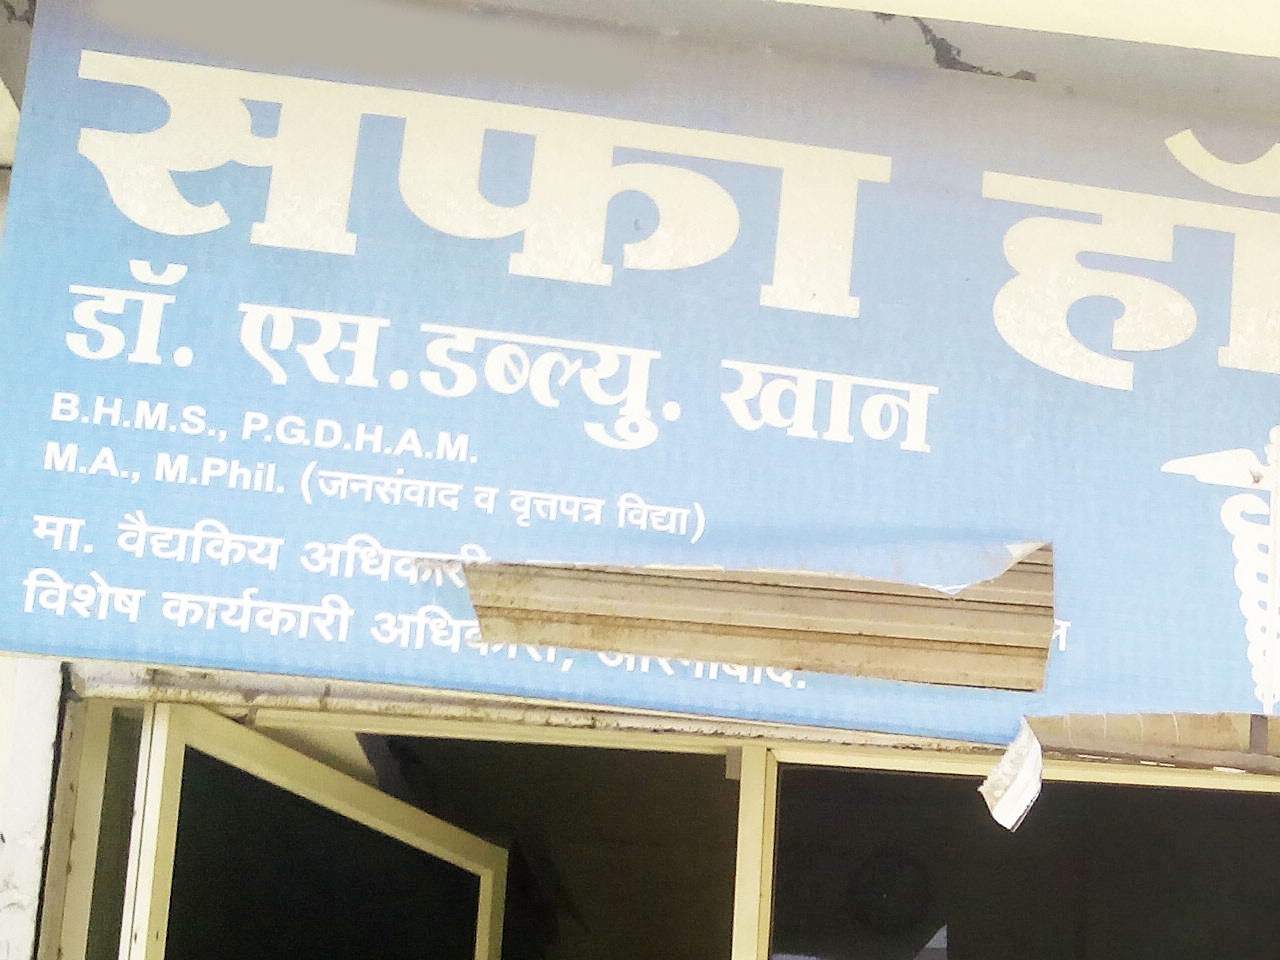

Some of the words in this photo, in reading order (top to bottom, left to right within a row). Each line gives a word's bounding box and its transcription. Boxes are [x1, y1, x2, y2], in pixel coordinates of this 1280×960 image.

[78, 49, 892, 319] सफा
[65, 259, 194, 368] डॉ.
[720, 357, 939, 455] खान
[50, 391, 228, 443] B.H.M.S.,
[241, 410, 479, 464] P.G.D.H.A.M.
[43, 441, 141, 485] M.A.,
[154, 452, 286, 494] M.Phil.
[300, 461, 464, 512] (जनसंवाद
[473, 485, 499, 515] व
[509, 489, 606, 528] वृत्तपत्र
[616, 492, 706, 545] विद्या)
[31, 514, 95, 553] मा.
[117, 510, 286, 571] वैद्यकिय
[22, 567, 147, 624] विशेष
[161, 587, 355, 643] कार्यकारी
